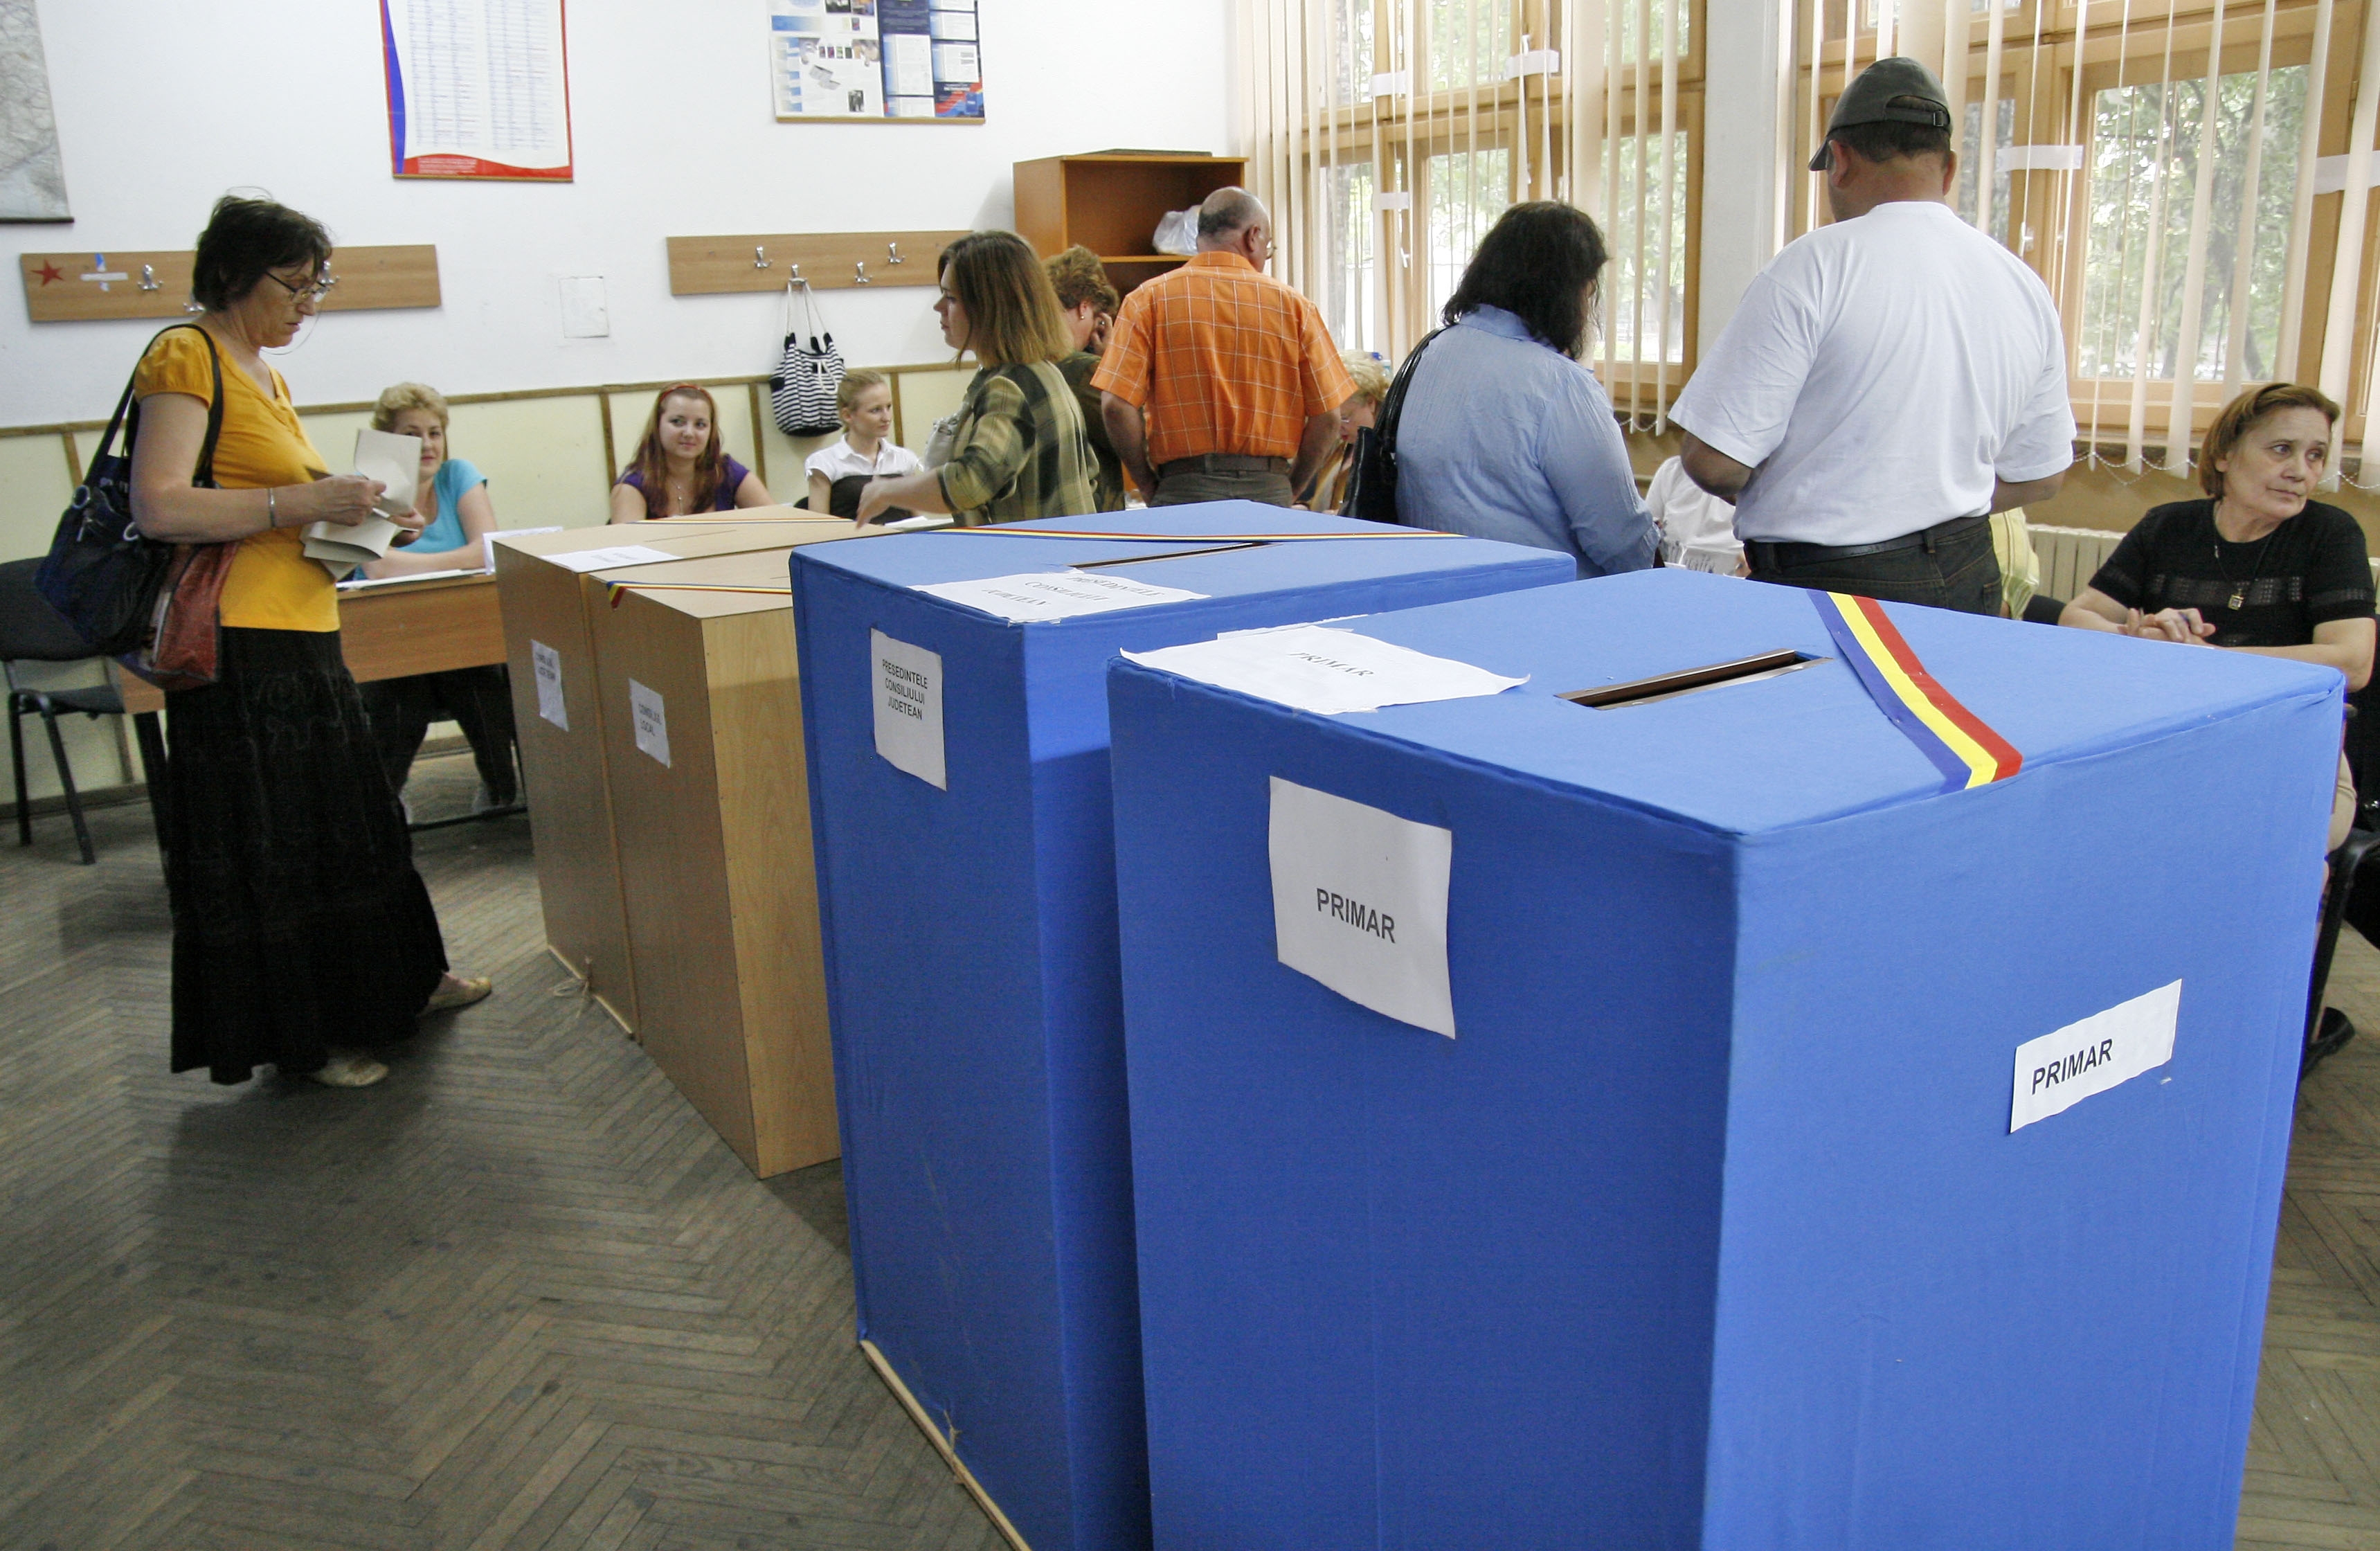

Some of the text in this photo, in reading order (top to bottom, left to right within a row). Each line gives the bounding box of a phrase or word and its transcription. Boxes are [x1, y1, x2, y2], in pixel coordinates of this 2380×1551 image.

[882, 658, 928, 690] PRESEDINTELE
[1288, 652, 1373, 676] PRIMAR
[885, 677, 925, 705] CONSILIULUI
[887, 695, 922, 720] JUDETEAN
[1316, 888, 1396, 943] PRIMAR
[2032, 1038, 2113, 1095] PRIMAR
